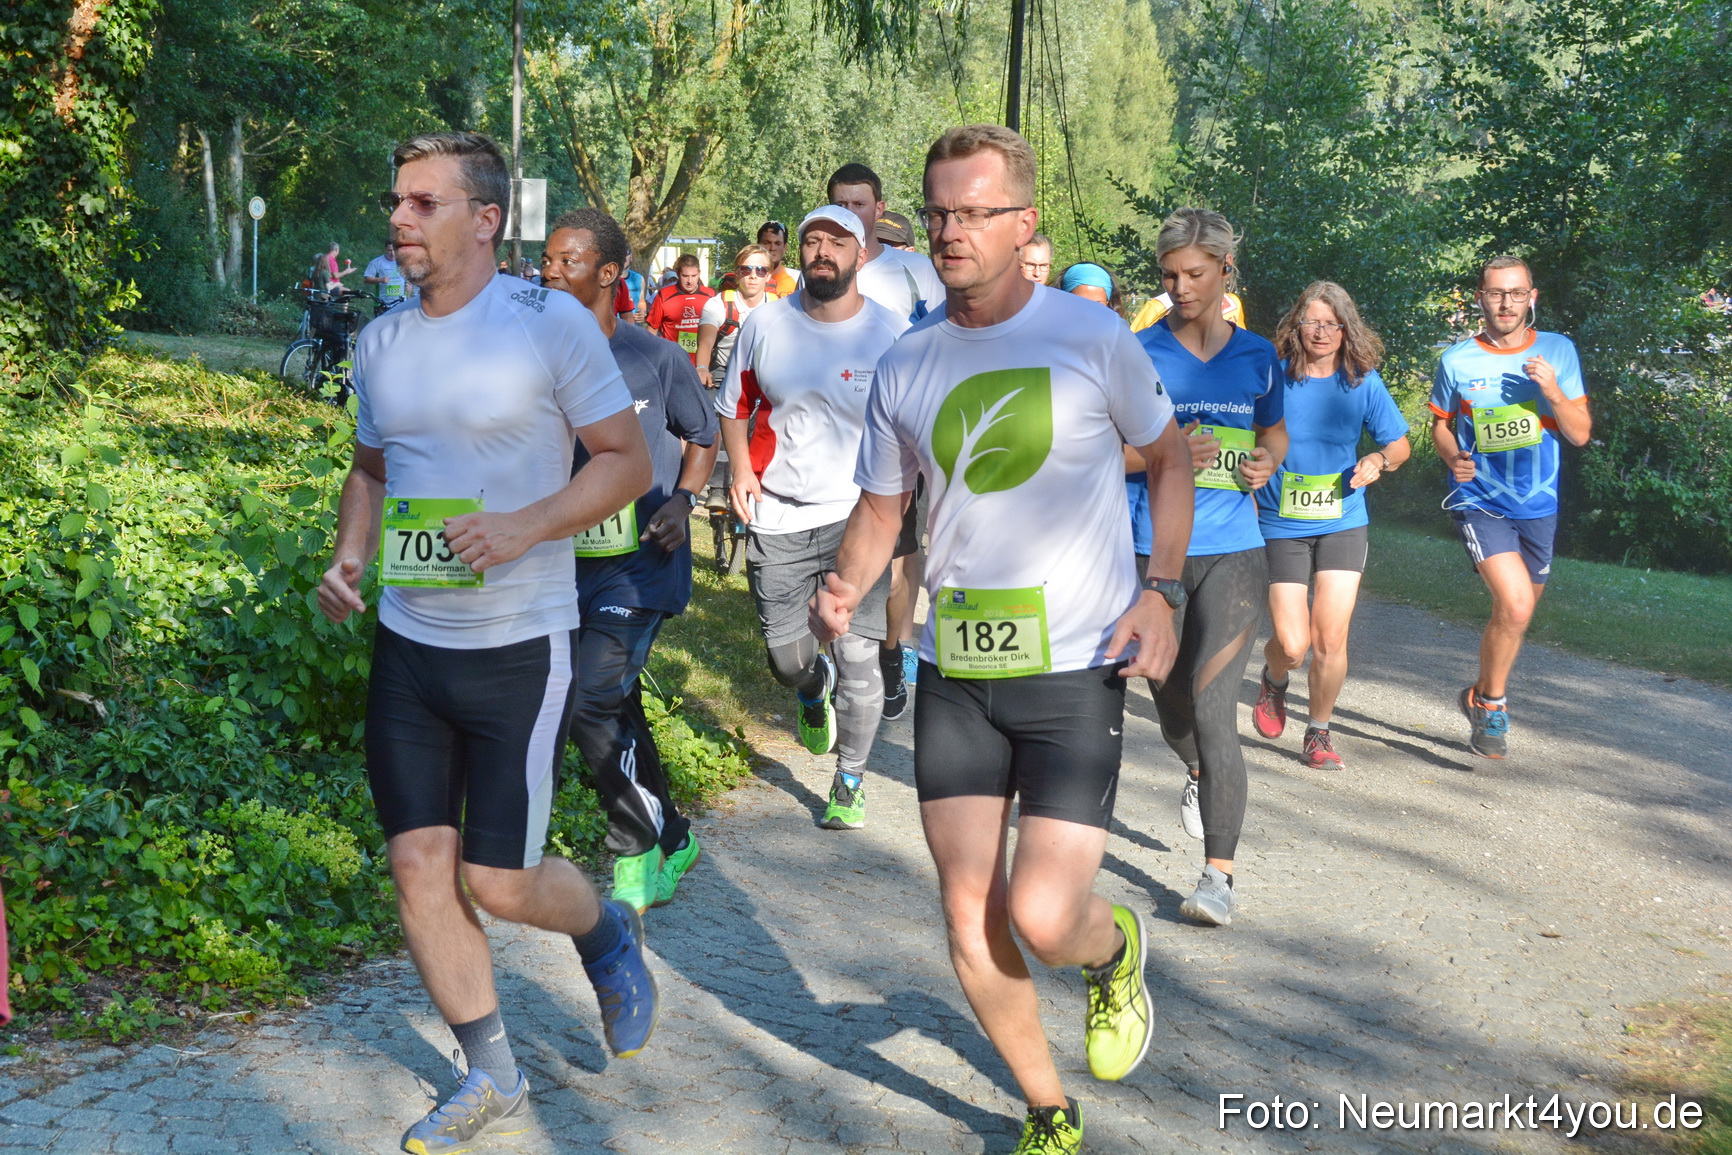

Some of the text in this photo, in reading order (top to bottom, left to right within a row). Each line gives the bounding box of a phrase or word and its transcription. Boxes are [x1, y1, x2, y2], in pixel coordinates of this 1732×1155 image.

[510, 292, 545, 313] adidas
[1483, 418, 1531, 440] 1589
[1289, 490, 1334, 506] 1044
[398, 531, 455, 562] 703
[390, 563, 466, 572] Hermsdorf Norman
[956, 621, 1019, 653] 182
[950, 653, 1030, 662] Bredenbröker Dirk
